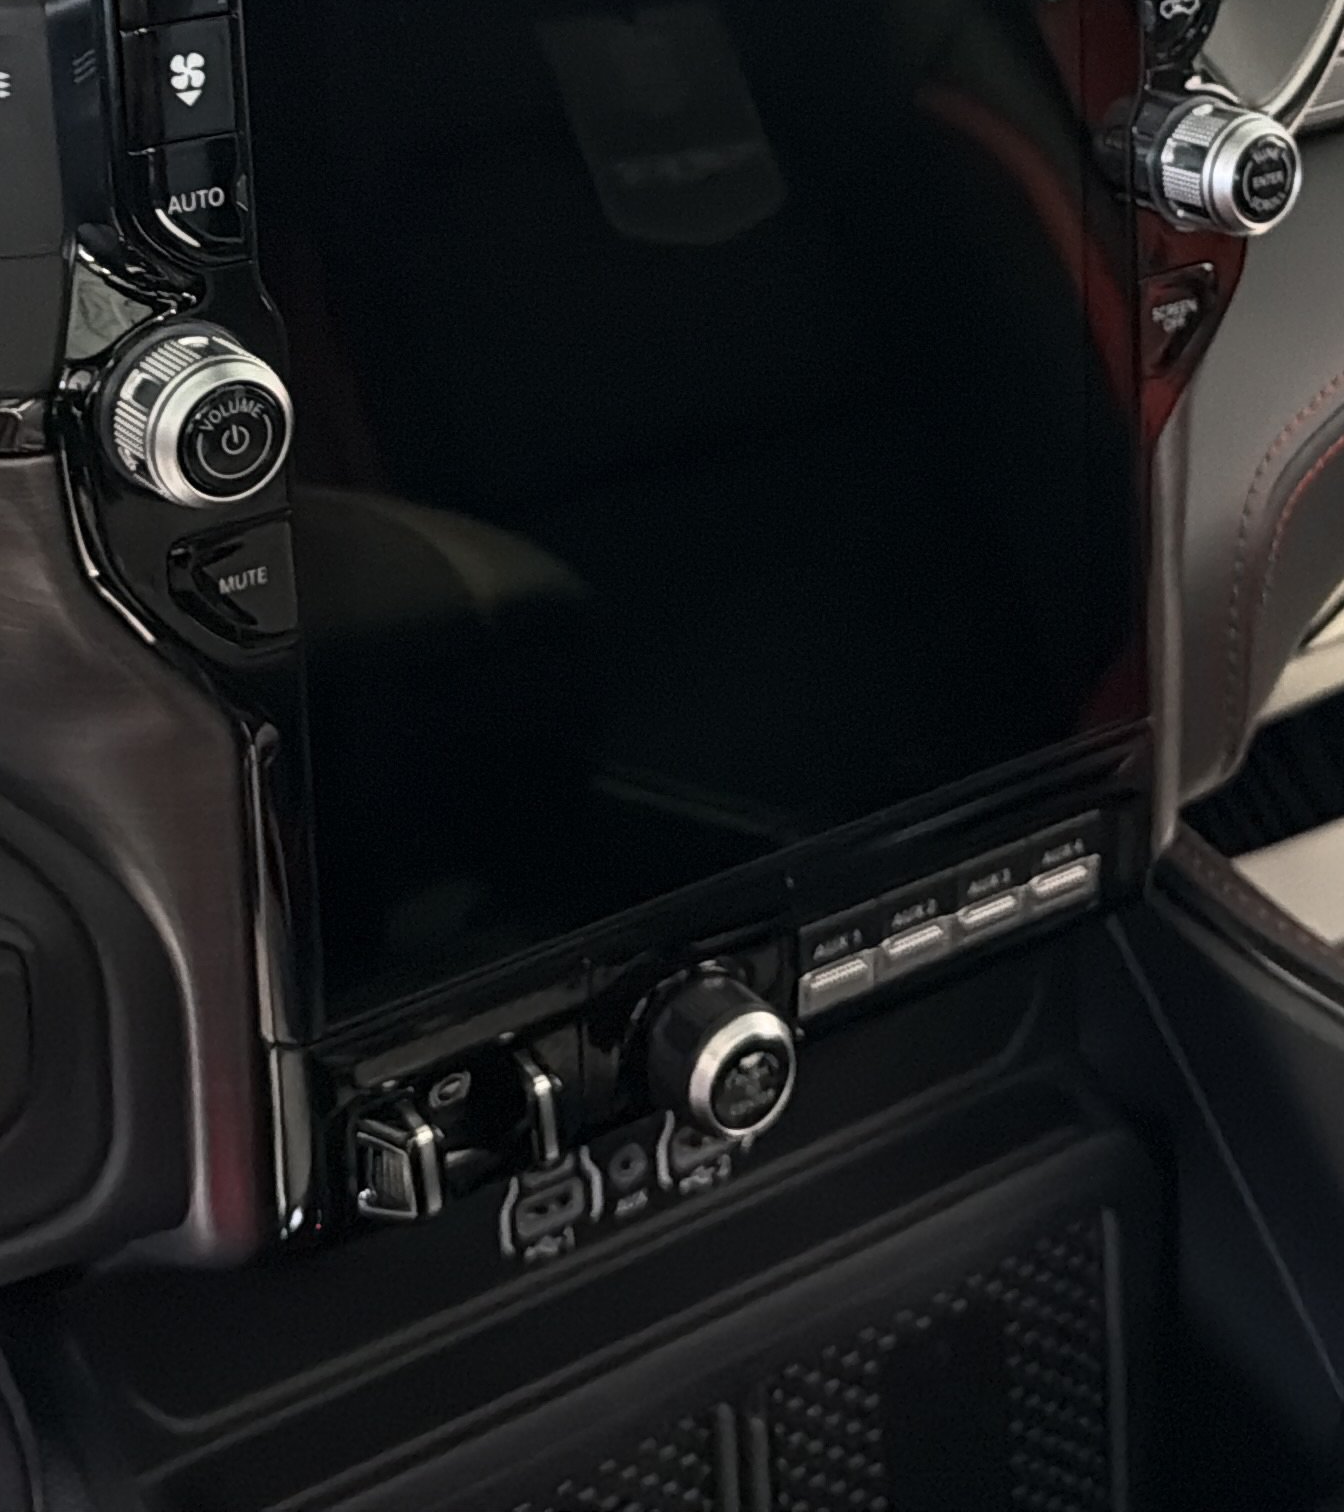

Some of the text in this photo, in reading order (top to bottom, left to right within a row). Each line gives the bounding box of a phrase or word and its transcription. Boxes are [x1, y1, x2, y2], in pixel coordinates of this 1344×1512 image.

[167, 186, 225, 216] AUTO
[199, 396, 266, 433] VOLUME
[218, 566, 269, 595] MUTE
